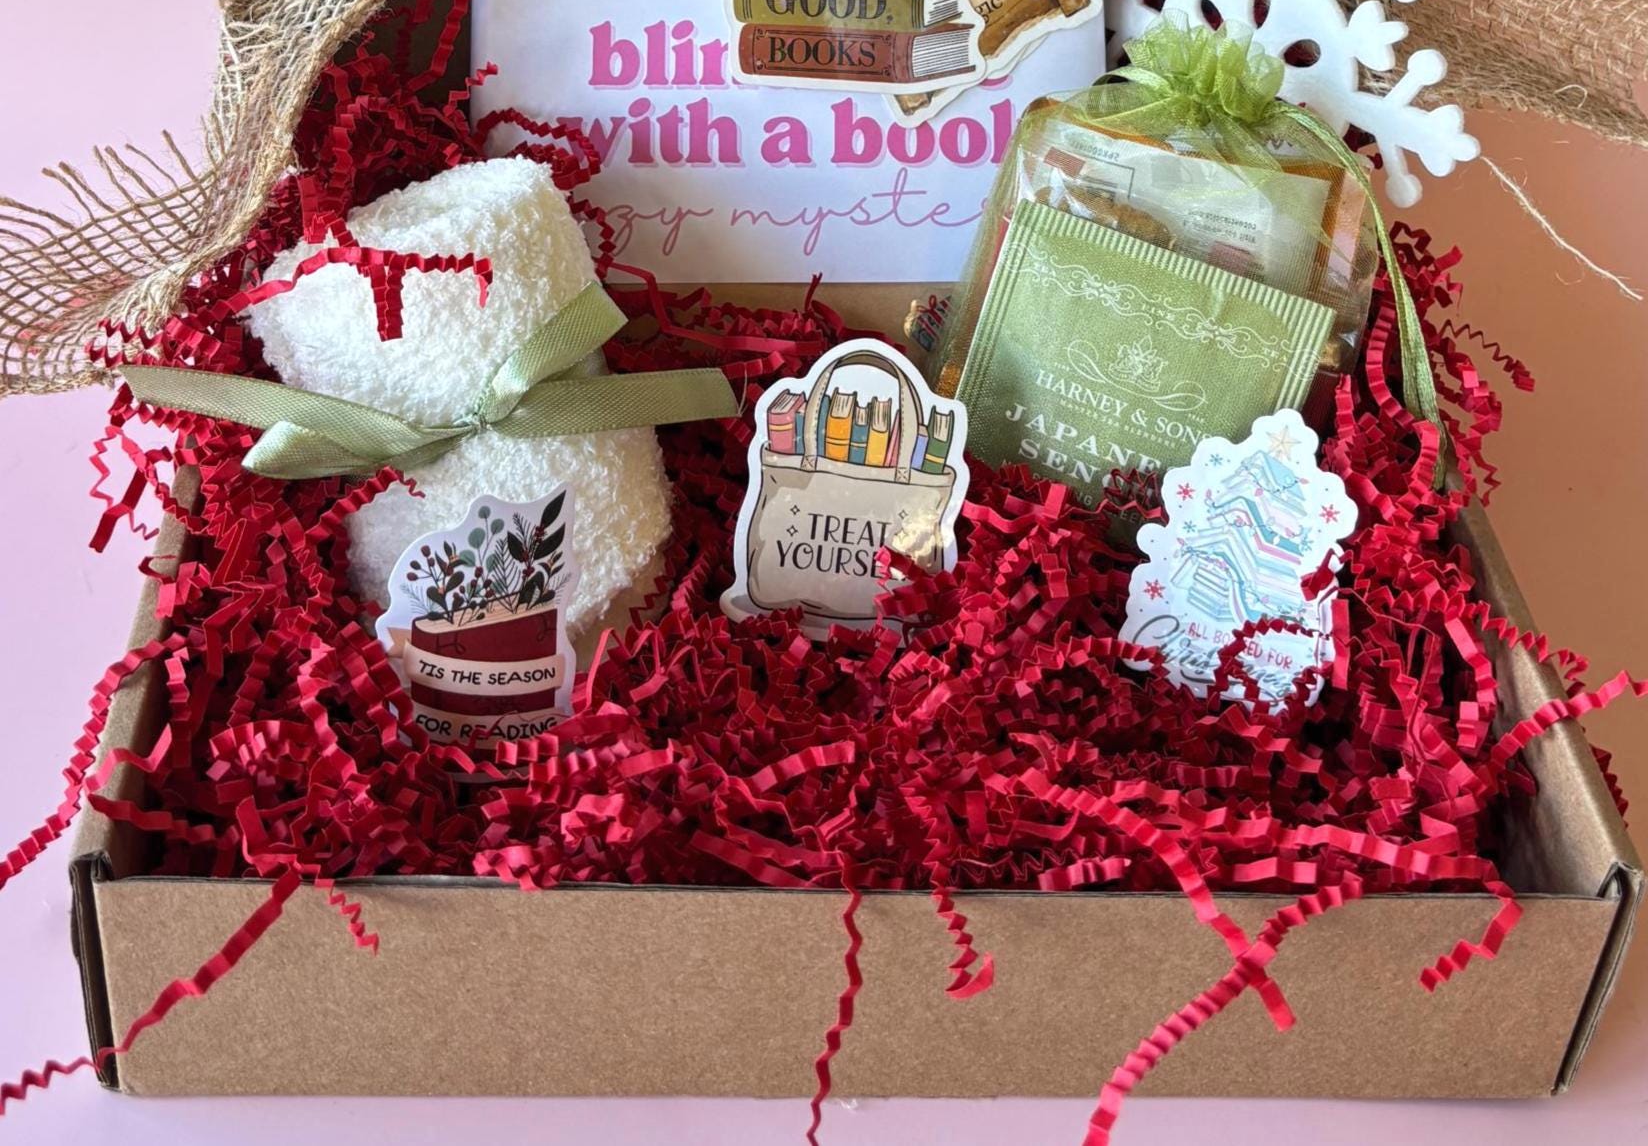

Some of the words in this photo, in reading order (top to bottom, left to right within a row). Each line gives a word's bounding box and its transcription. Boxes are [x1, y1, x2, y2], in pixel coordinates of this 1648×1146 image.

[767, 35, 877, 68] BOOKS
[760, 115, 814, 167] a
[729, 166, 987, 256] myste
[1035, 368, 1129, 419] HARNEY
[1131, 408, 1149, 428] &
[1005, 403, 1162, 476] JAPANE
[808, 512, 893, 548] TREAT
[1186, 621, 1209, 641] ALL
[417, 658, 445, 680] 'TIS
[450, 669, 482, 686] THE
[487, 665, 557, 686] SEASON
